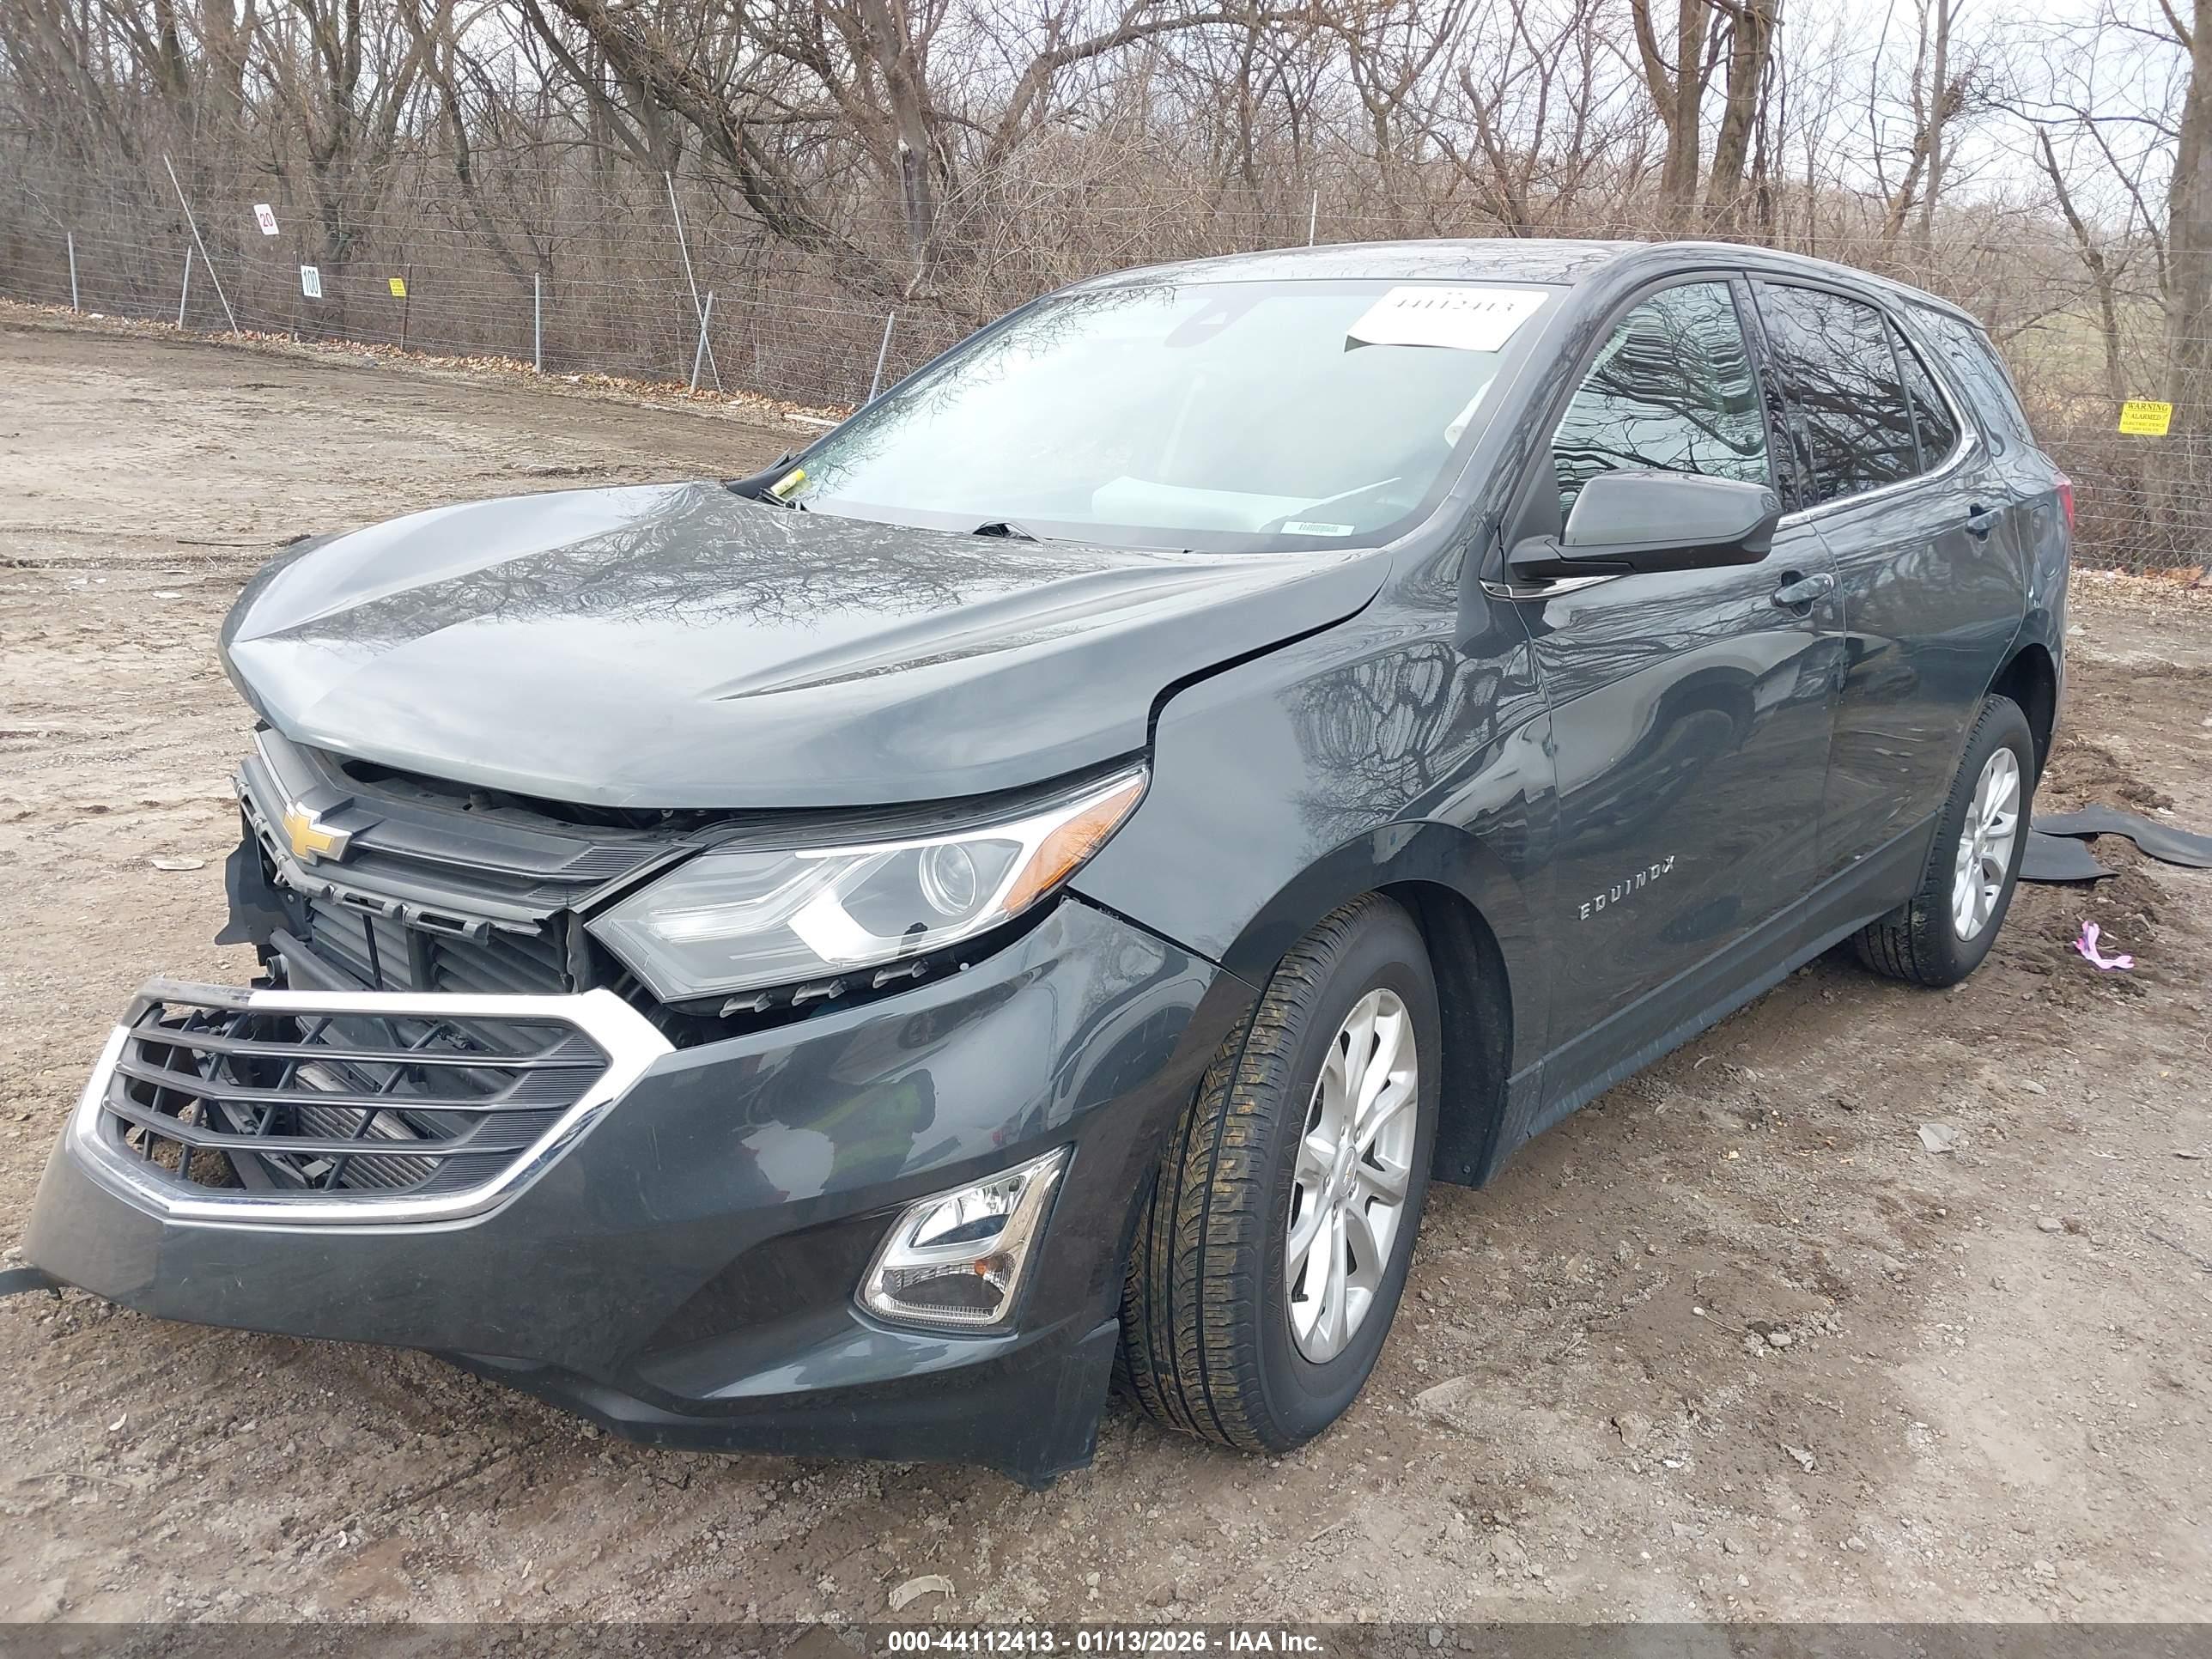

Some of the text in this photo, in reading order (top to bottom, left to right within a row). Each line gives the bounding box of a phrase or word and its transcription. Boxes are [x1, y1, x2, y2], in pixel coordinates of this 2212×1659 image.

[259, 212, 274, 228] 20
[303, 269, 319, 295] 100
[2128, 402, 2168, 411] WARNING
[1578, 854, 1675, 921] EQUINOX
